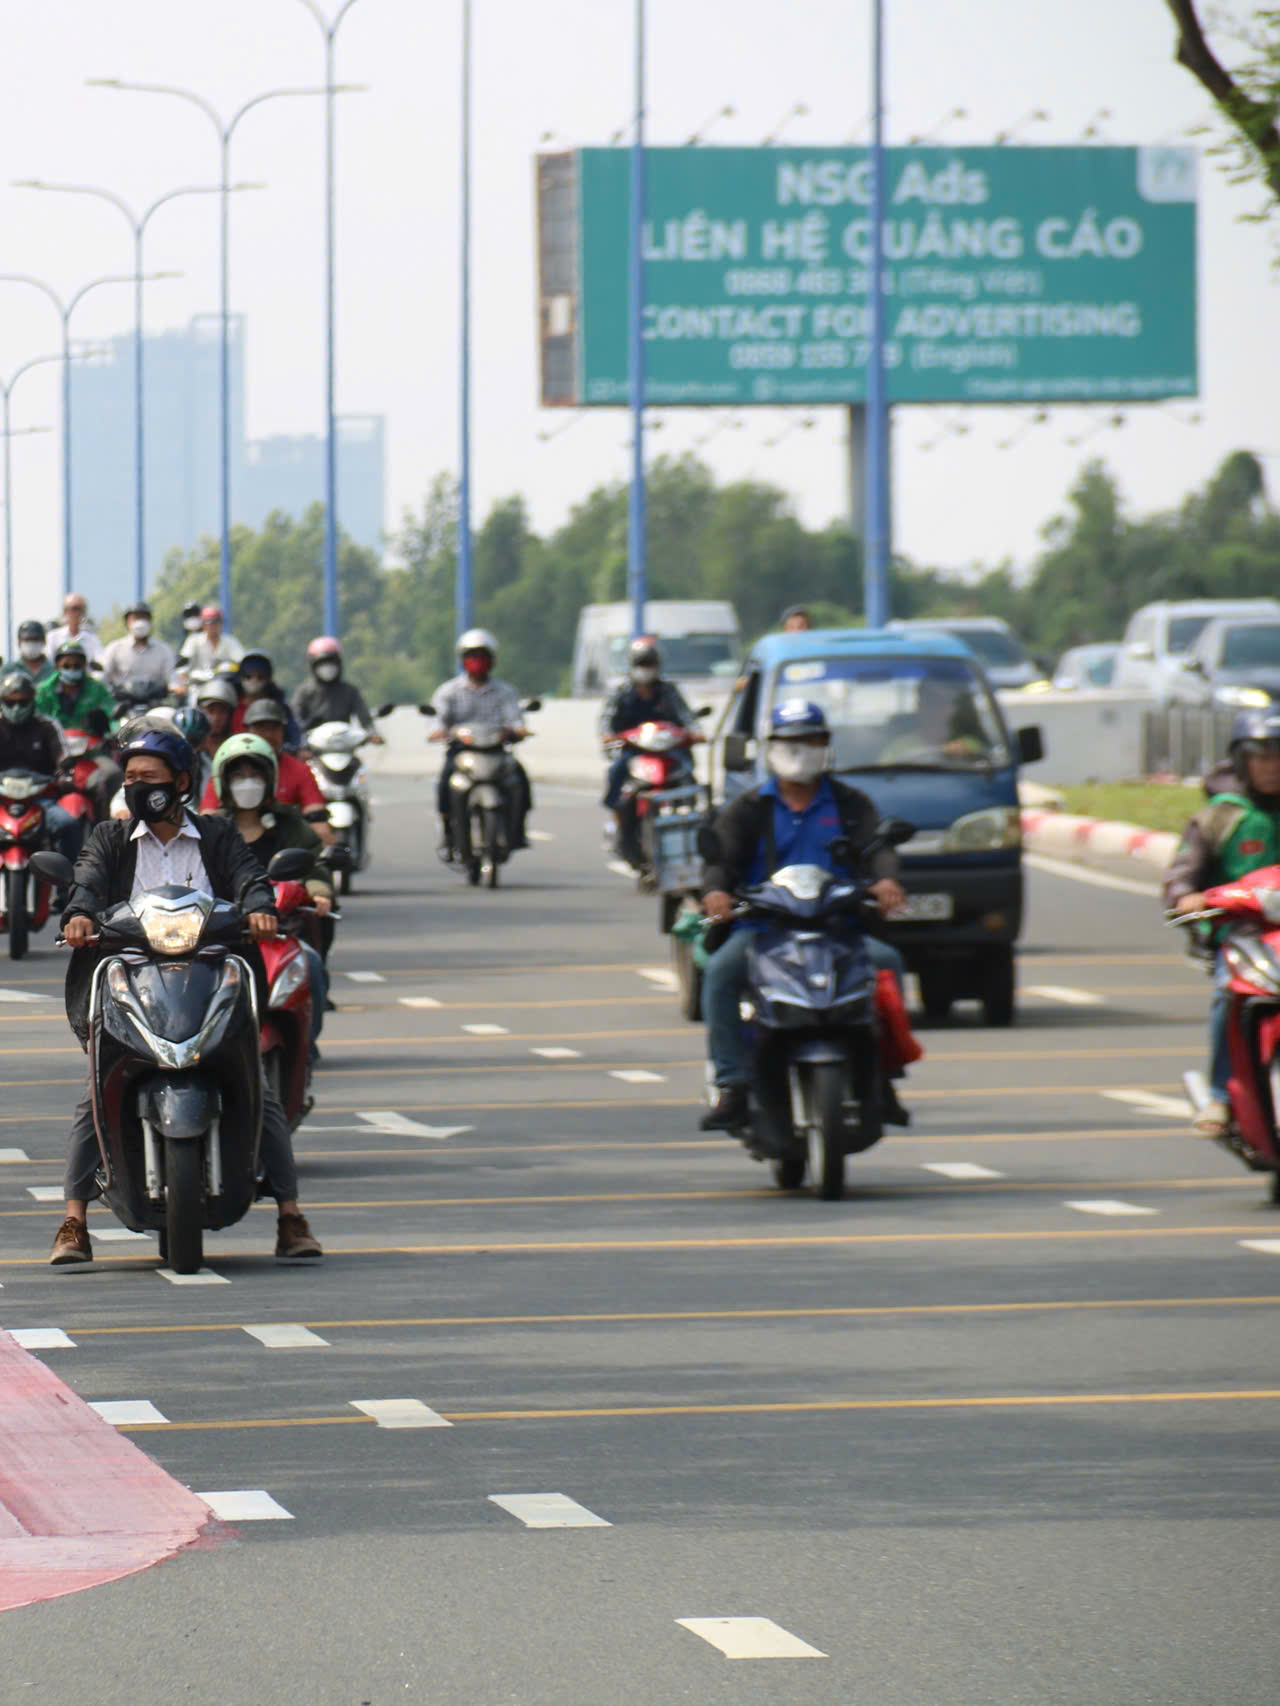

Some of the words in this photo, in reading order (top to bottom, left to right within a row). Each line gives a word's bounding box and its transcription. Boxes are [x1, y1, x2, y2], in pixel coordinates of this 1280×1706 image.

[893, 159, 987, 204] Ads
[1036, 206, 1142, 259] CÁO
[641, 304, 806, 339] CONTACT
[895, 302, 1141, 338] ADVERTISING
